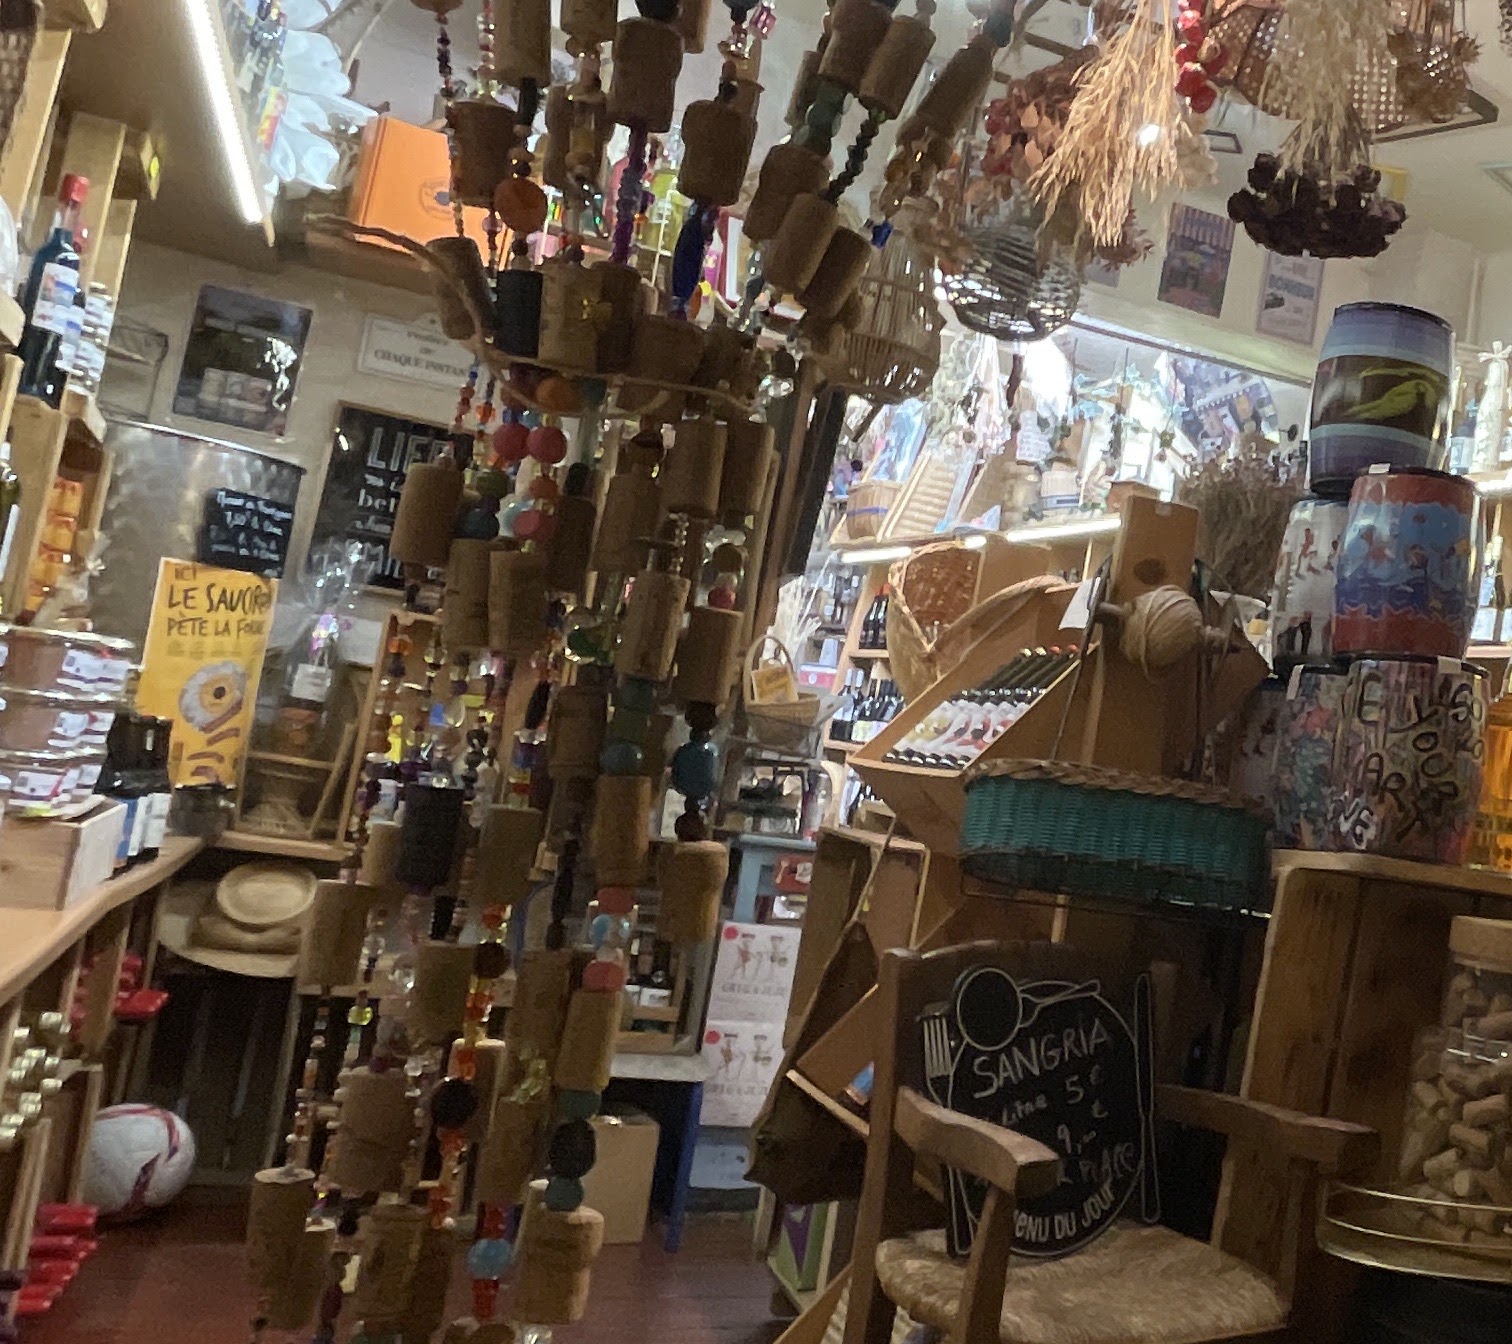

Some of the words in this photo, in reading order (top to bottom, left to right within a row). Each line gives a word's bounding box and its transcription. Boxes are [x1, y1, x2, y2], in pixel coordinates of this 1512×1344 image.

[425, 361, 466, 377] INSTAN
[168, 584, 198, 610] LE
[166, 611, 208, 637] PÈTE
[214, 619, 231, 637] LA
[972, 1017, 1114, 1099] SANGRIA
[1054, 1212, 1077, 1241] DU
